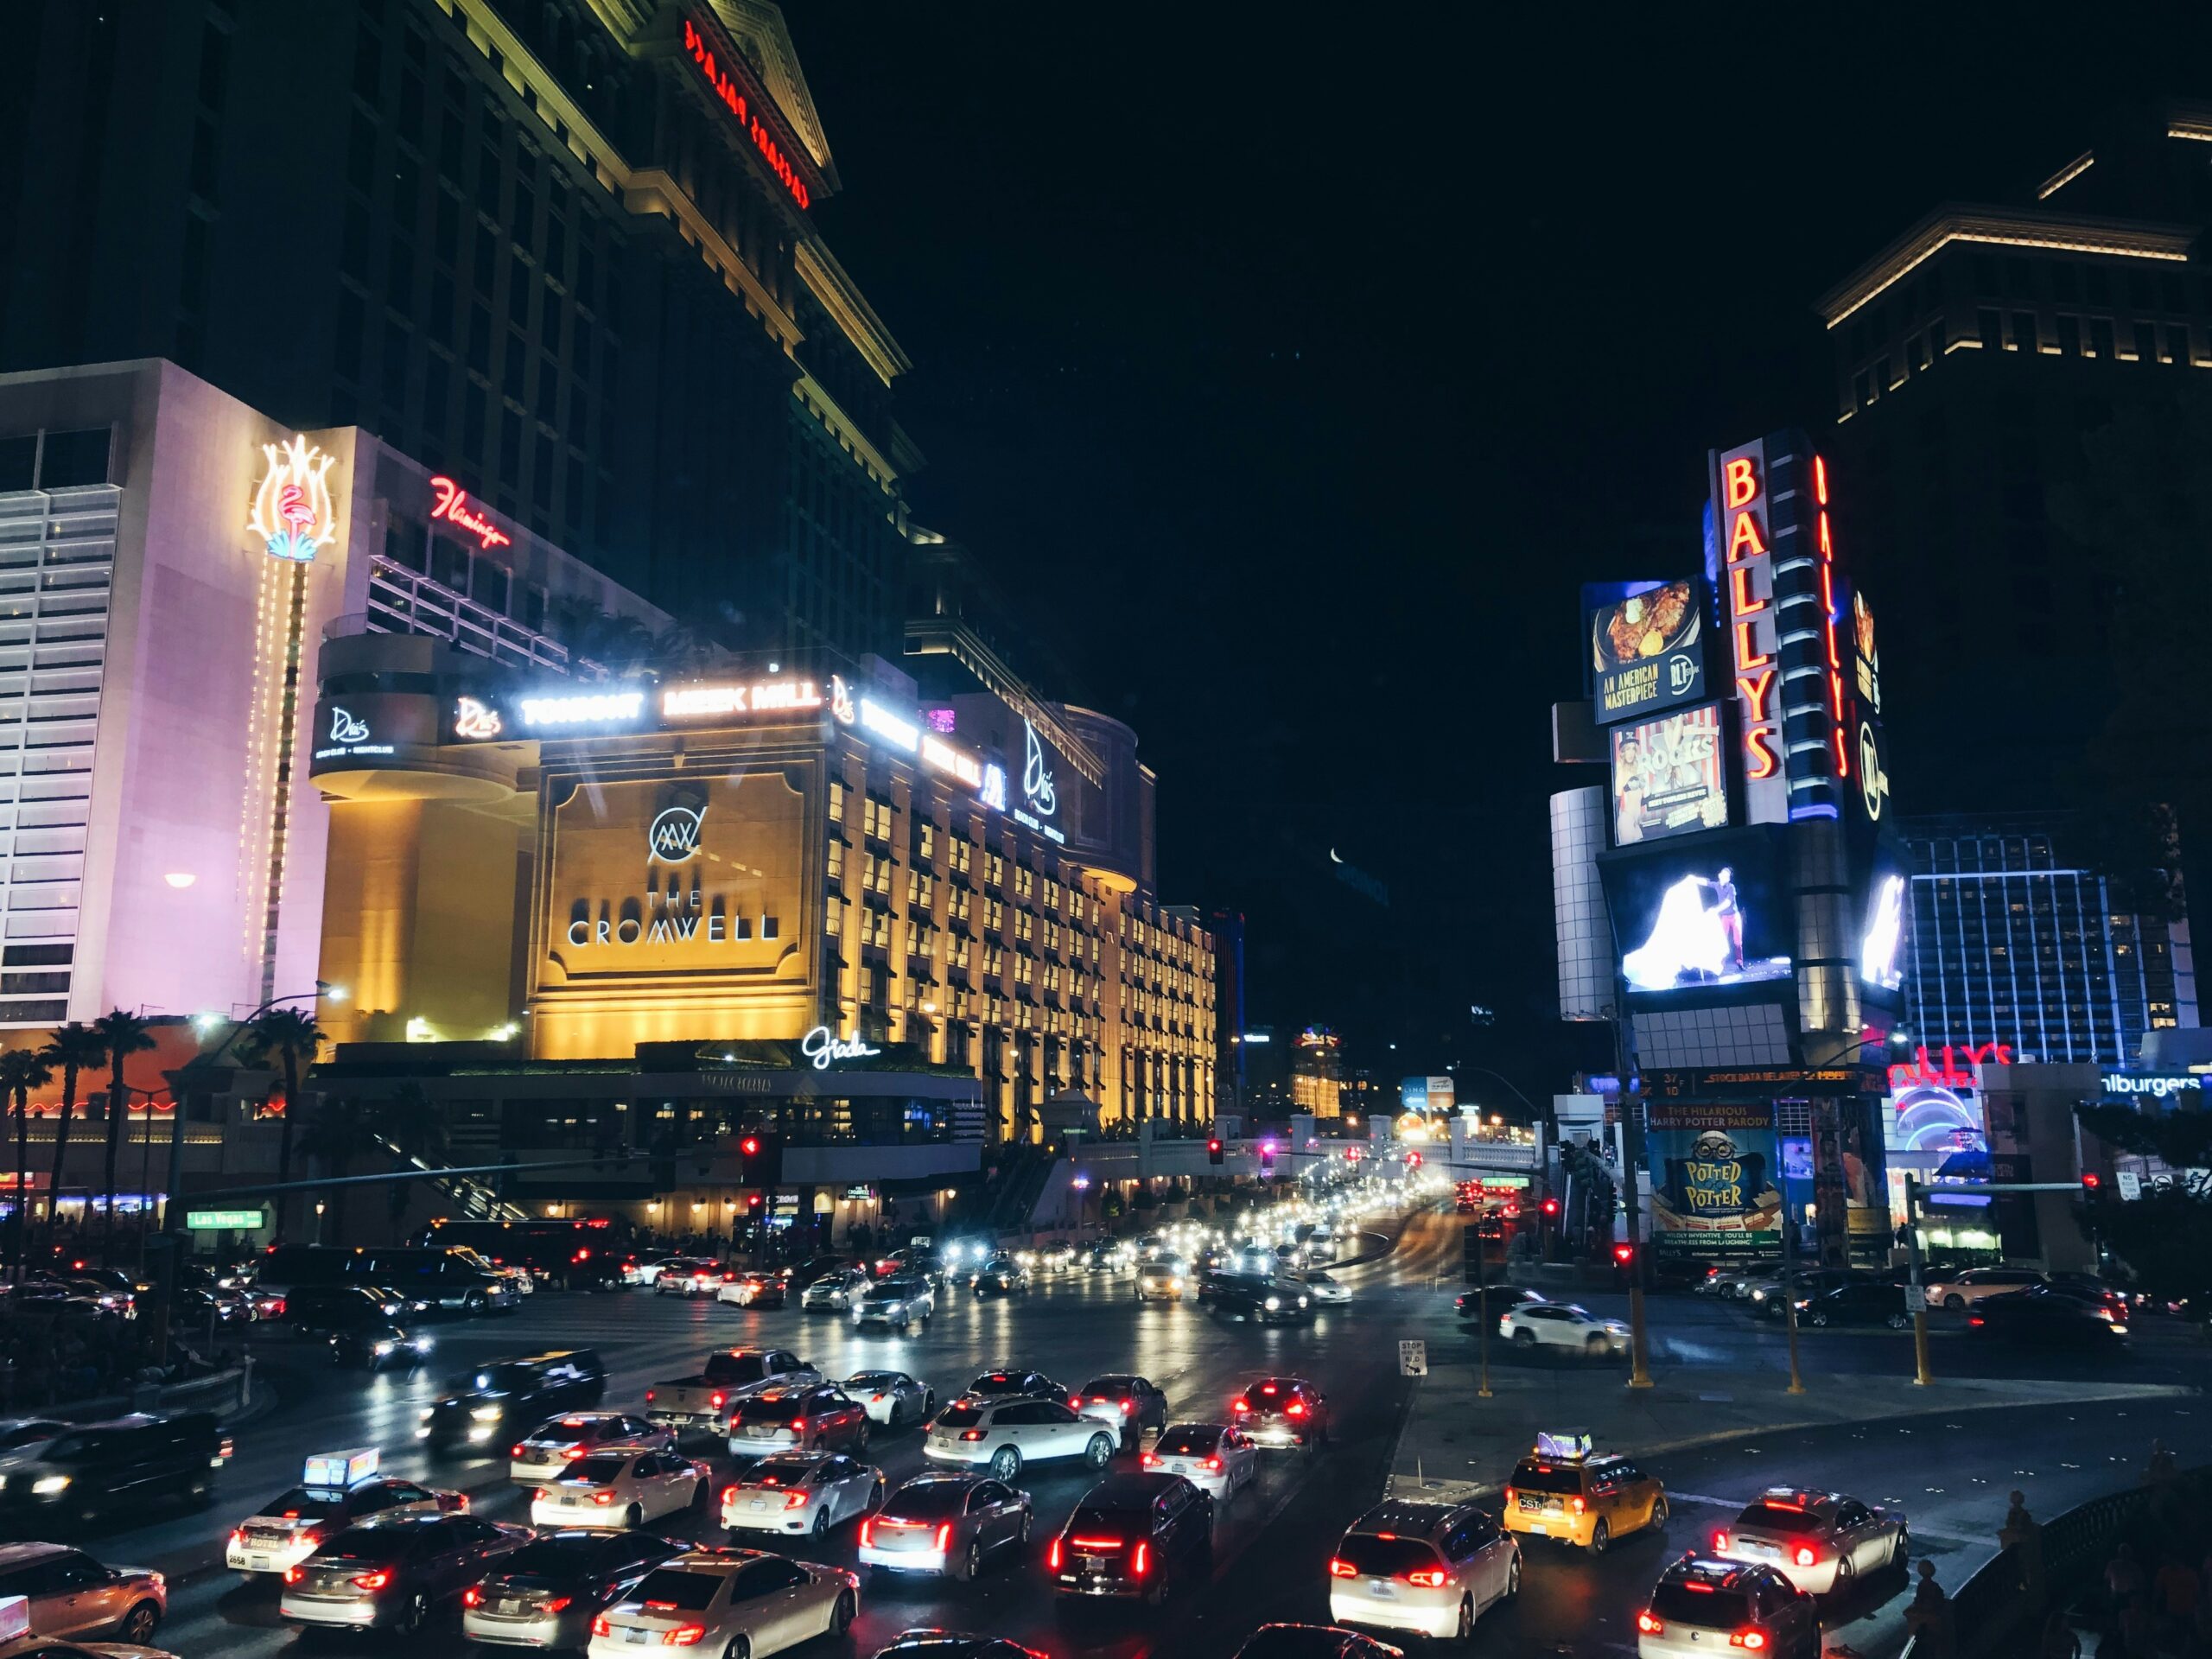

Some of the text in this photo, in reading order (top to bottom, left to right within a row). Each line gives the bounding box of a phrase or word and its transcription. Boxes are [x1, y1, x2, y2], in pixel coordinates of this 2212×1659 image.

[430, 476, 510, 549] Flamingo
[1604, 662, 1658, 694] AN AMERICAN
[1670, 661, 1688, 688] BLT
[664, 681, 822, 716] MEEK MILL
[1605, 681, 1658, 710] MASTERPIECE
[646, 890, 701, 908] THE
[567, 914, 778, 946] CROMWELL
[802, 1026, 881, 1070] Giada
[1650, 1116, 1770, 1127] HARRY POTTER PARODY
[1668, 1107, 1747, 1116] THE HILARIOUS
[1685, 1160, 1742, 1186] POTTED
[1685, 1184, 1743, 1213] POTTER
[194, 1212, 213, 1225] Las
[214, 1211, 244, 1227] Vegas
[250, 1538, 279, 1549] HOTEL
